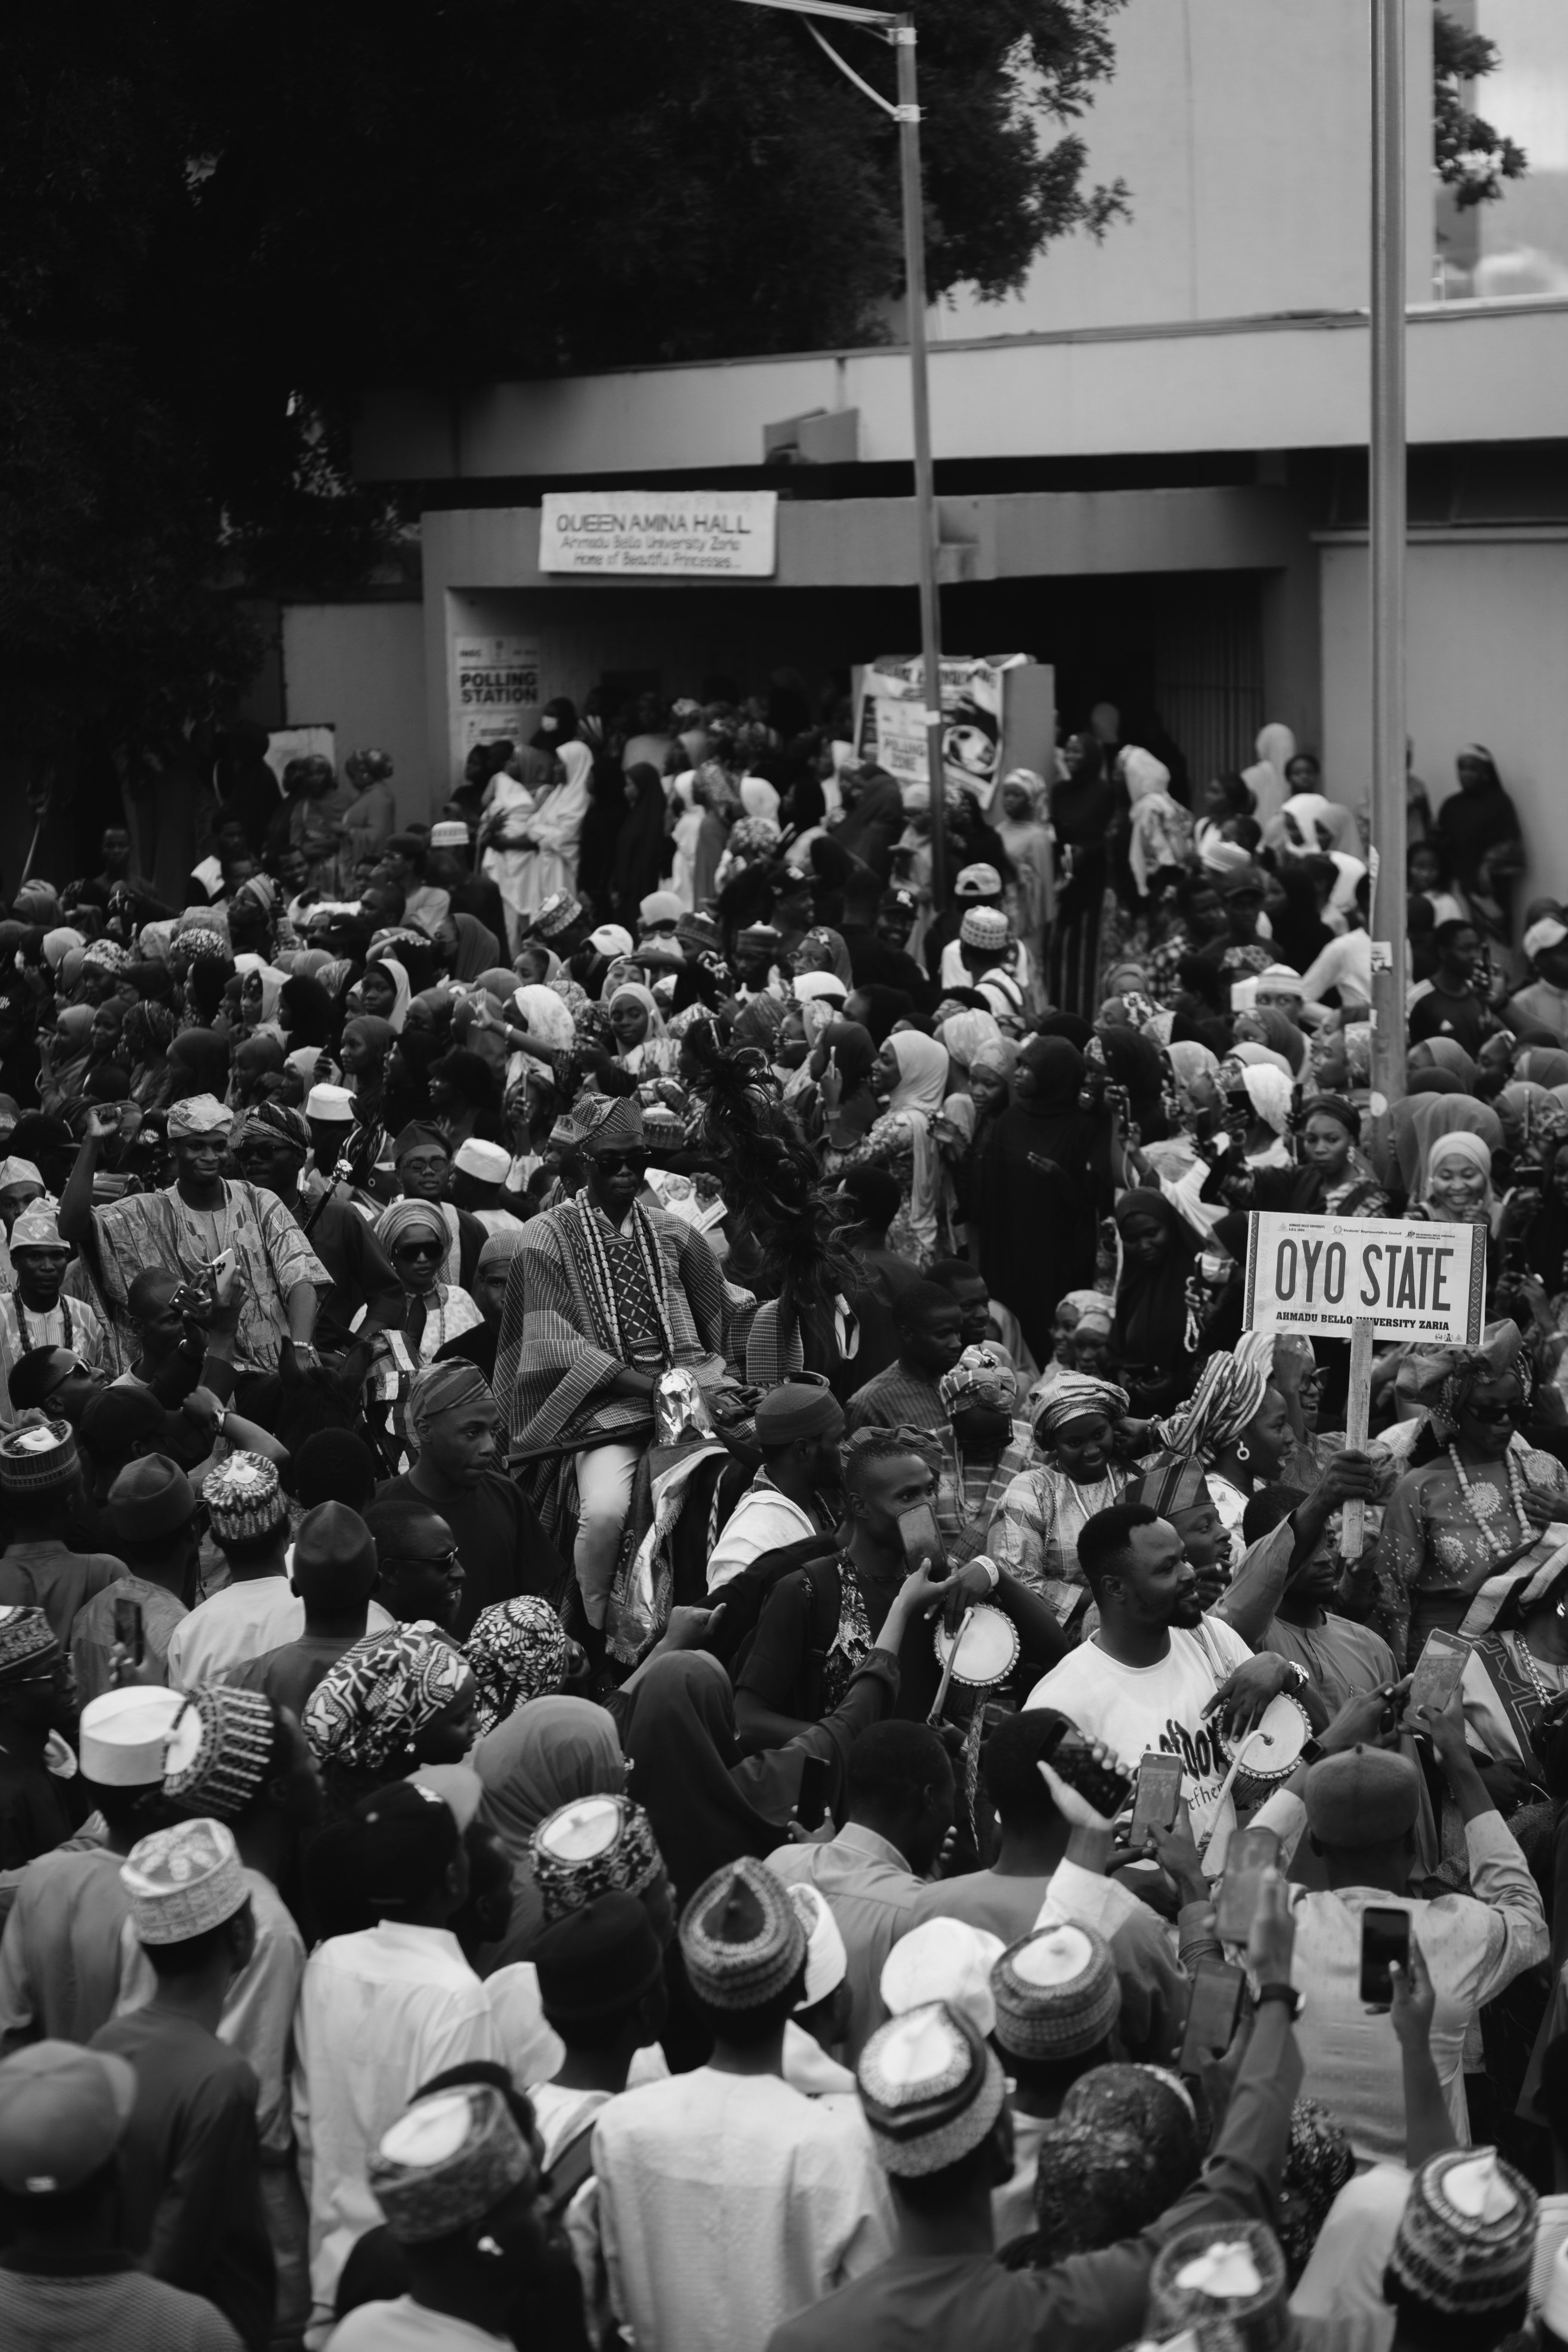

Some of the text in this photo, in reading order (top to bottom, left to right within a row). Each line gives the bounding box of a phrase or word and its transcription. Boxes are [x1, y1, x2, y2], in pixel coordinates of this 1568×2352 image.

[556, 514, 751, 534] QUEEN AMINA HALL
[459, 672, 537, 688] POLLING
[461, 688, 538, 704] STATION
[1275, 1238, 1454, 1311] OYO STATE
[1276, 1312, 1318, 1322] AHMADU
[1321, 1314, 1353, 1324] BELLO
[1419, 1320, 1449, 1330] ZARIA
